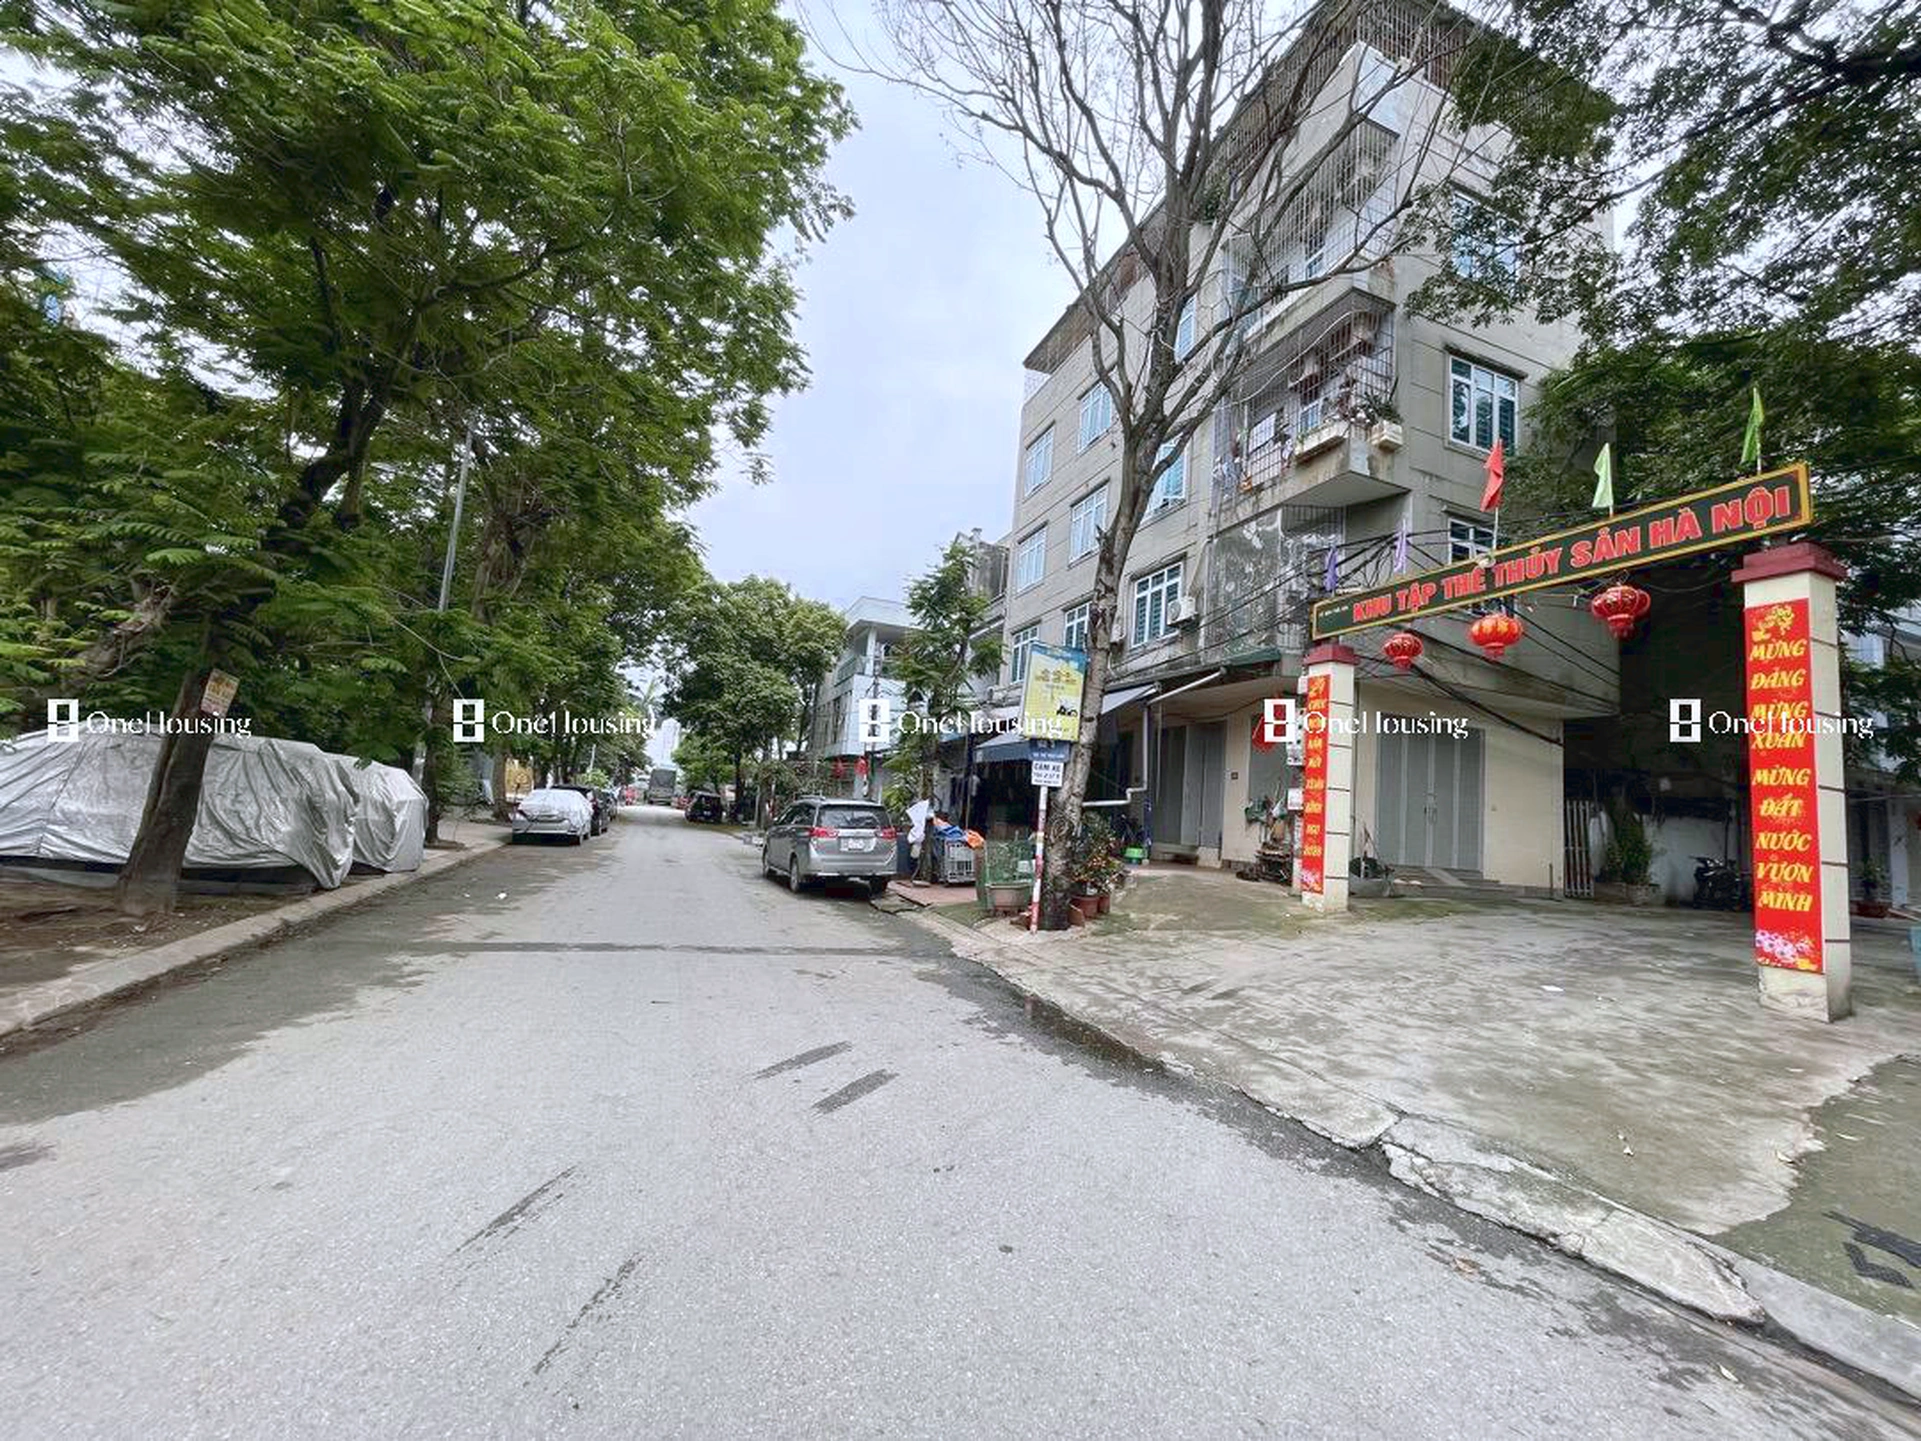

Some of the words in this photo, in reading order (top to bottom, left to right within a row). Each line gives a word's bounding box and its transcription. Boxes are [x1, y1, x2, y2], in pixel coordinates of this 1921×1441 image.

[1352, 594, 1392, 623] KHU
[1396, 582, 1437, 613] TẬP
[1492, 546, 1563, 588] THỦY
[1570, 526, 1641, 568] SẢN
[1648, 507, 1702, 548] HÀ
[1711, 485, 1790, 534] NỘI
[1750, 638, 1808, 661] MỪNG
[1750, 666, 1807, 690] ĐẢNG
[1751, 698, 1809, 720] MỪNG
[1752, 763, 1812, 786] MỪNG
[1759, 792, 1804, 818] ĐẤT
[1755, 829, 1813, 852] NƯỚC
[1756, 861, 1814, 884] VƯƠN
[1757, 888, 1813, 912] MÌNH
